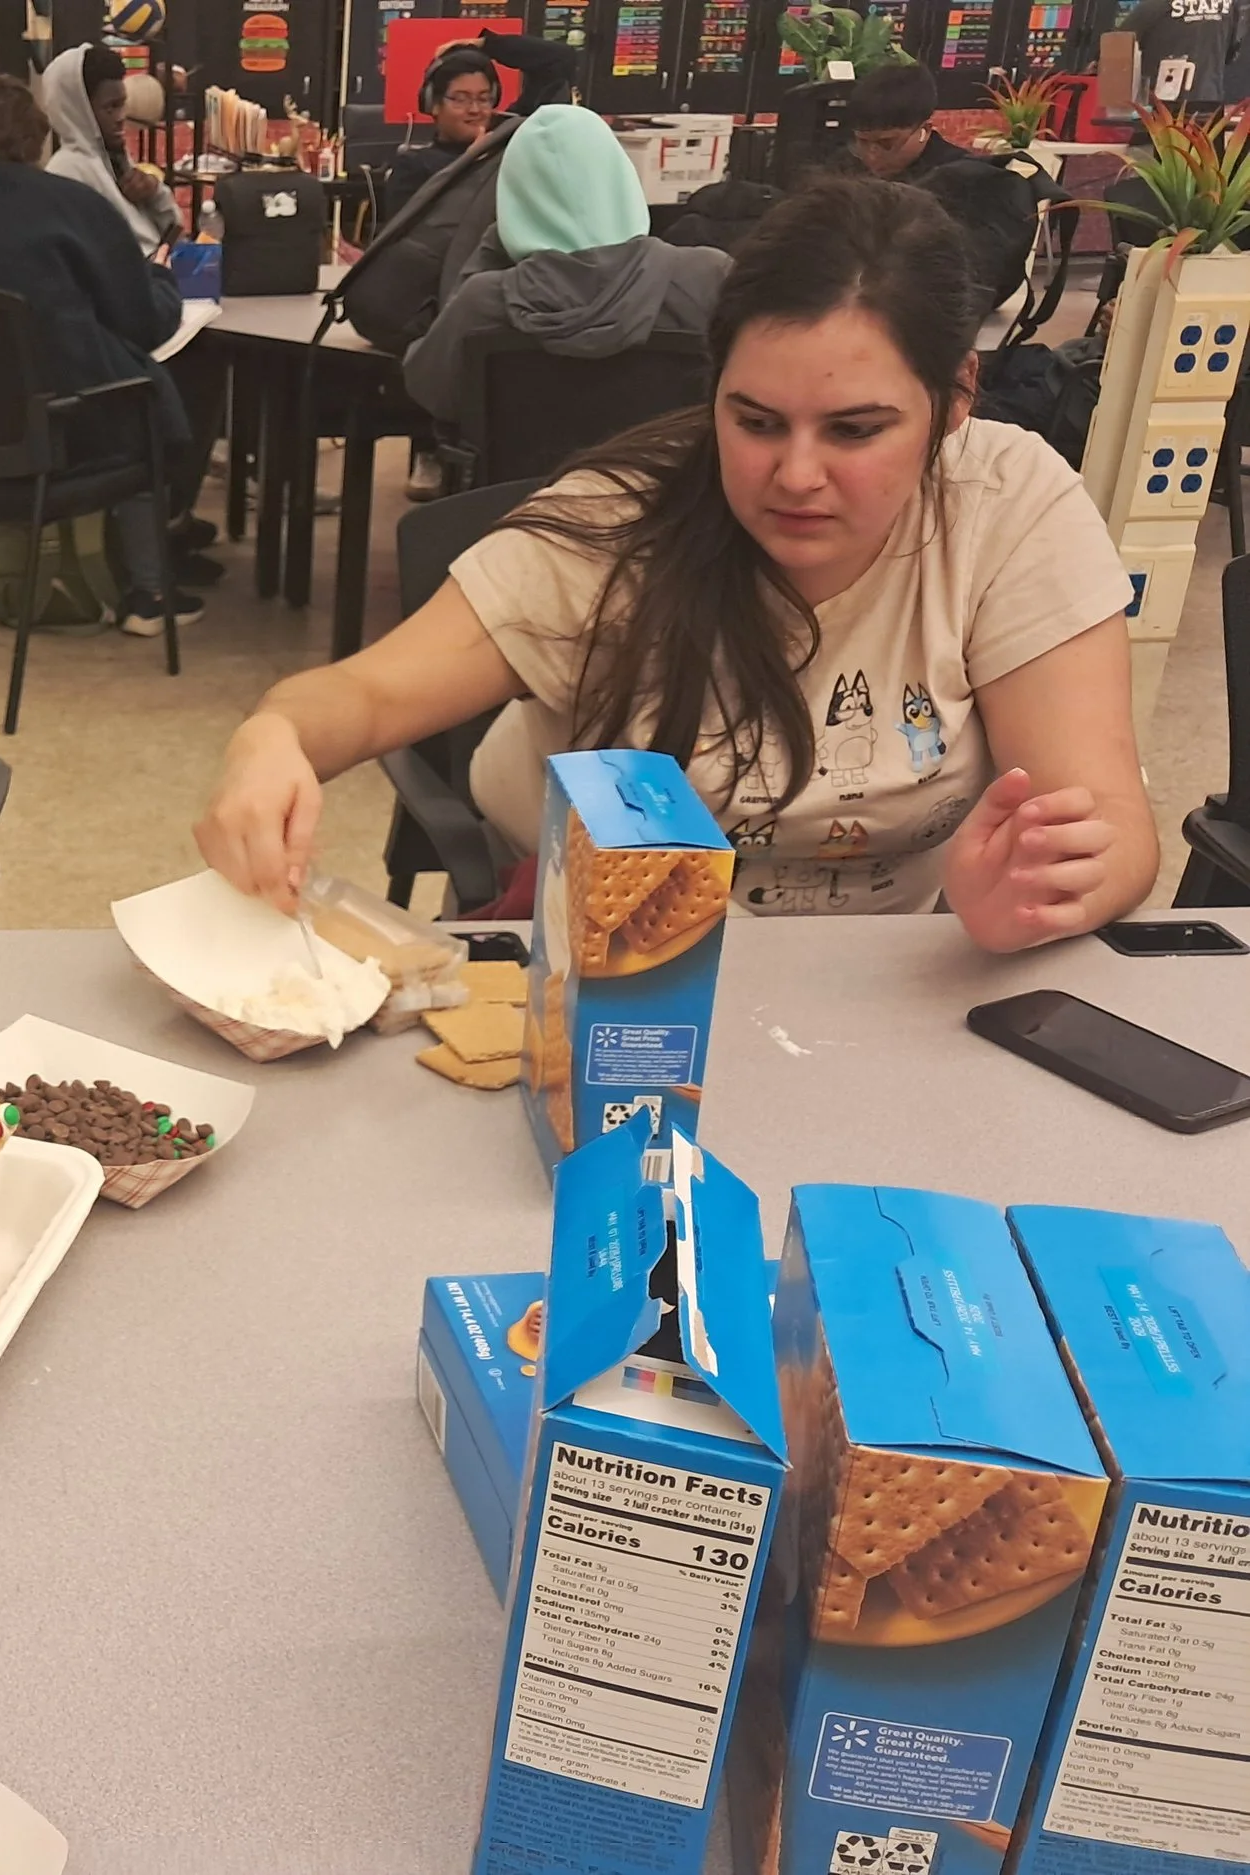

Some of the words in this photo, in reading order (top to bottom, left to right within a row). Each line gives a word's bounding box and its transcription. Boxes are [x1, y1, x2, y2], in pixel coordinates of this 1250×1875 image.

[556, 1446, 677, 1488] Nutrition
[685, 1475, 764, 1507] Facts
[553, 1470, 586, 1485] about
[590, 1478, 605, 1489] 13
[607, 1483, 658, 1503] servings
[661, 1495, 681, 1508] per
[685, 1499, 742, 1519] container
[548, 1505, 581, 1518] Amount
[583, 1515, 598, 1524] per
[600, 1518, 633, 1531] serving
[552, 1480, 589, 1498] Serving
[591, 1490, 612, 1502] size
[622, 1497, 630, 1506] 2
[631, 1499, 648, 1511] full
[650, 1503, 689, 1519] cracker
[692, 1512, 726, 1528] sheets
[728, 1520, 756, 1535] (31g)
[546, 1514, 642, 1548] Calories
[690, 1543, 750, 1572] 130
[1128, 1542, 1171, 1557] Serving
[1172, 1550, 1196, 1560] size
[1207, 1554, 1215, 1562] 2
[1216, 1555, 1235, 1564] full
[1132, 1531, 1170, 1543] about
[1174, 1537, 1190, 1546] 13
[1192, 1539, 1247, 1555] servings
[541, 1548, 571, 1562] Total
[574, 1556, 592, 1568] Fat
[595, 1563, 607, 1573] 3g
[721, 1590, 742, 1601] 4%
[551, 1576, 577, 1588] Trans
[579, 1583, 594, 1593] Fat
[688, 1571, 711, 1582] Daily
[1122, 1569, 1159, 1578] Amount
[1180, 1577, 1215, 1587] serving
[552, 1564, 597, 1581] Saturated
[599, 1576, 616, 1586] Fat
[719, 1602, 739, 1613] 3%
[1117, 1577, 1224, 1604] Calories
[535, 1584, 601, 1606] Cholesterol
[602, 1601, 624, 1613] 0mg
[714, 1625, 734, 1637] 0%
[1109, 1613, 1142, 1624] Total
[1145, 1619, 1166, 1628] Fat
[533, 1596, 576, 1612] Sodium
[578, 1607, 610, 1622] 135mg
[712, 1637, 732, 1648] 6%
[532, 1607, 561, 1620] Total
[563, 1615, 640, 1641] Carbohydrate
[642, 1634, 661, 1646] 24g
[710, 1649, 729, 1660] 9%
[541, 1633, 564, 1645] Total
[566, 1640, 599, 1654] Sugars
[1119, 1628, 1170, 1641] Saturated
[1172, 1635, 1190, 1644] Fat
[542, 1622, 575, 1637] Dietary
[577, 1630, 601, 1643] Fiber
[604, 1637, 616, 1647] 1g
[707, 1660, 727, 1671] 4%
[1116, 1640, 1146, 1651] Trans
[1148, 1645, 1166, 1654] Fat
[525, 1652, 564, 1668] Protein
[567, 1663, 579, 1672] 2g
[1094, 1661, 1142, 1675] Sodium
[1097, 1649, 1171, 1667] Cholesterol
[521, 1671, 555, 1686] Vitamin
[557, 1681, 565, 1689] D
[551, 1648, 589, 1663] Includes
[606, 1661, 636, 1675] Added
[638, 1669, 672, 1684] Sugars
[697, 1682, 722, 1694] 16%
[520, 1682, 556, 1698] Calcium
[558, 1692, 579, 1704] 0mg
[1091, 1673, 1124, 1684] Total
[1126, 1679, 1211, 1699] Carbohydrate
[1101, 1687, 1138, 1700] Dietary
[1140, 1693, 1167, 1703] Fiber
[518, 1694, 535, 1704] Iron
[1099, 1699, 1125, 1709] Total
[1126, 1704, 1163, 1716] Sugars
[516, 1704, 563, 1723] Potassium
[565, 1717, 585, 1729] 0mg
[1077, 1719, 1123, 1733] Protein
[875, 1735, 910, 1748] Great
[877, 1726, 912, 1739] Great
[510, 1742, 547, 1758] Calories
[548, 1753, 564, 1764] per
[566, 1758, 589, 1770] gram
[509, 1751, 523, 1760] Fat
[559, 1765, 619, 1787] Carbohydrate
[659, 1789, 690, 1803] Protein
